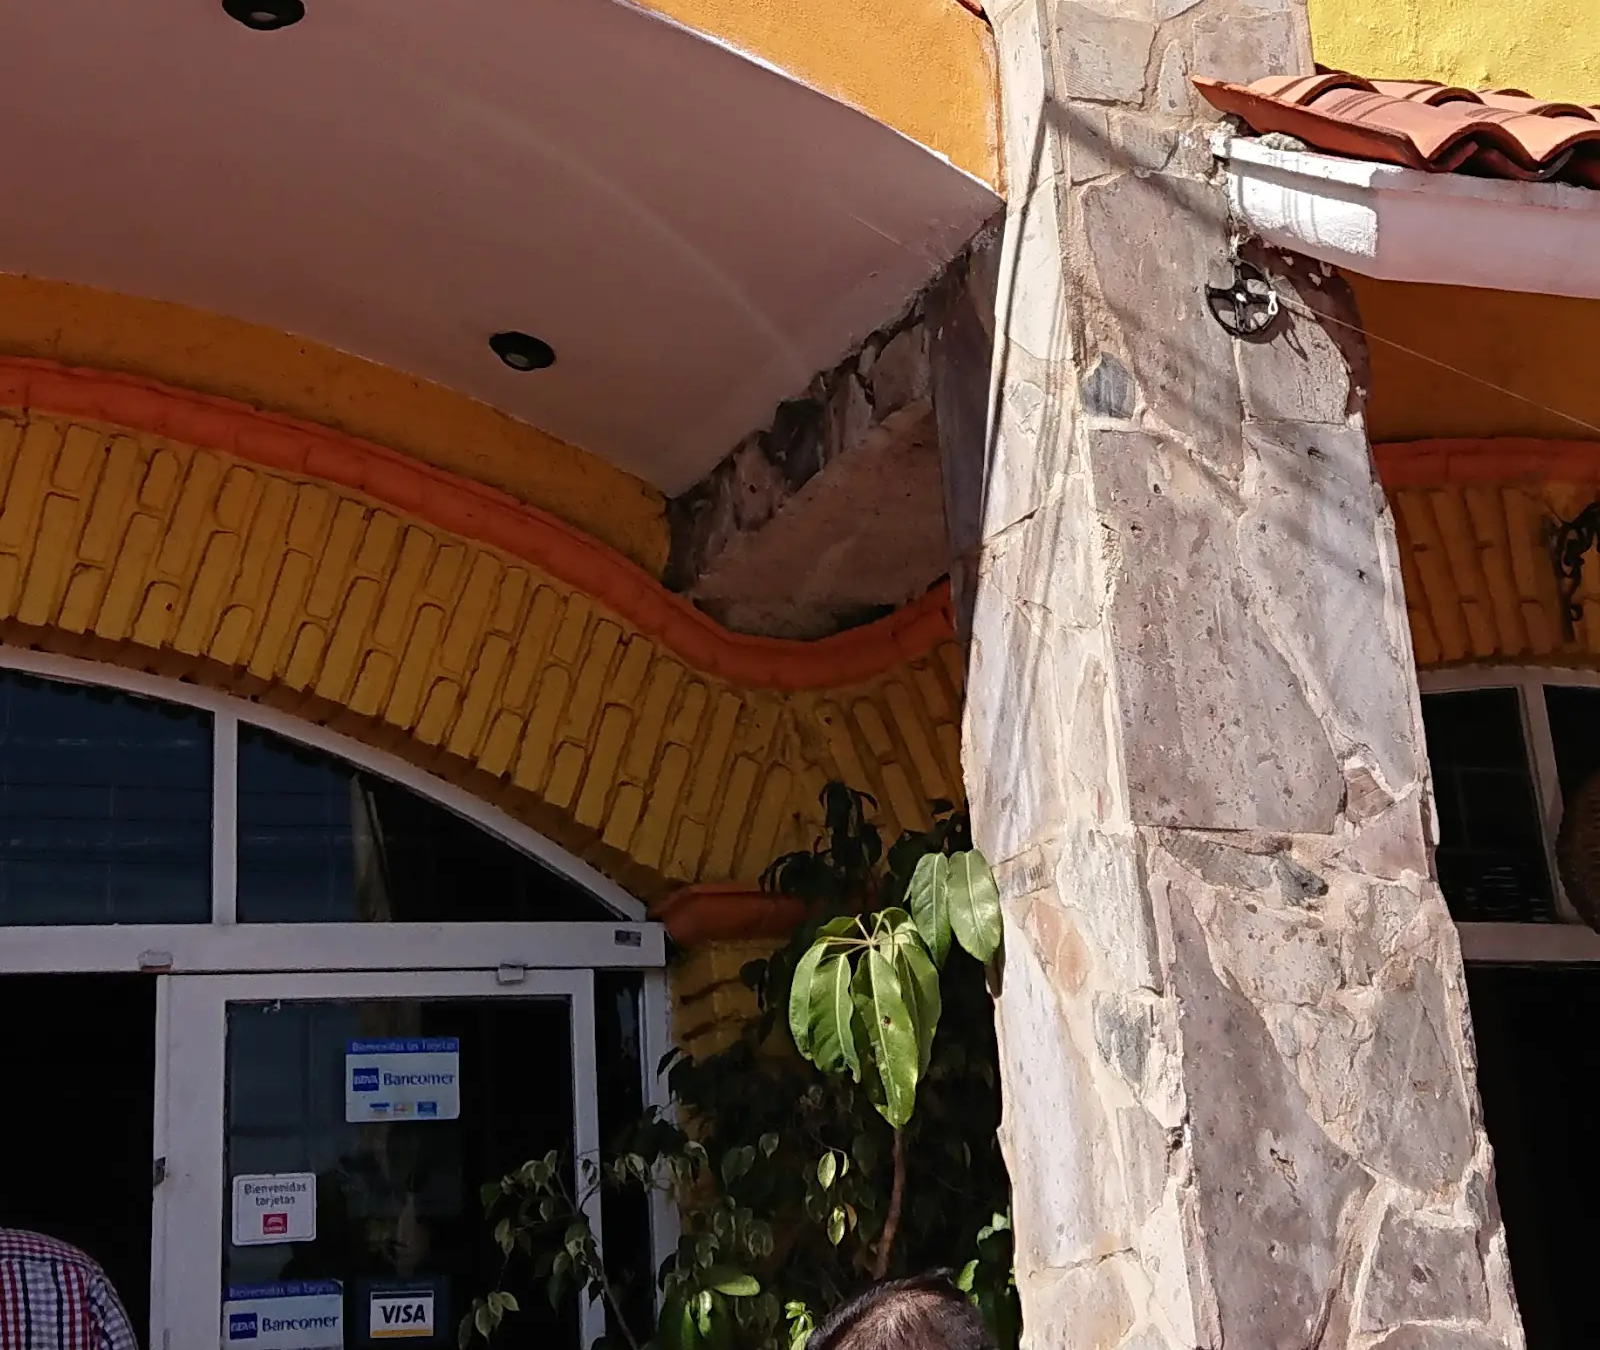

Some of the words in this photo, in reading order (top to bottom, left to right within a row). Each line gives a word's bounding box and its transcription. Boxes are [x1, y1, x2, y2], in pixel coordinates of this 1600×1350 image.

[383, 1072, 457, 1087] Bancomer
[261, 1314, 340, 1333] Bancomer
[380, 1304, 427, 1325] VISA
